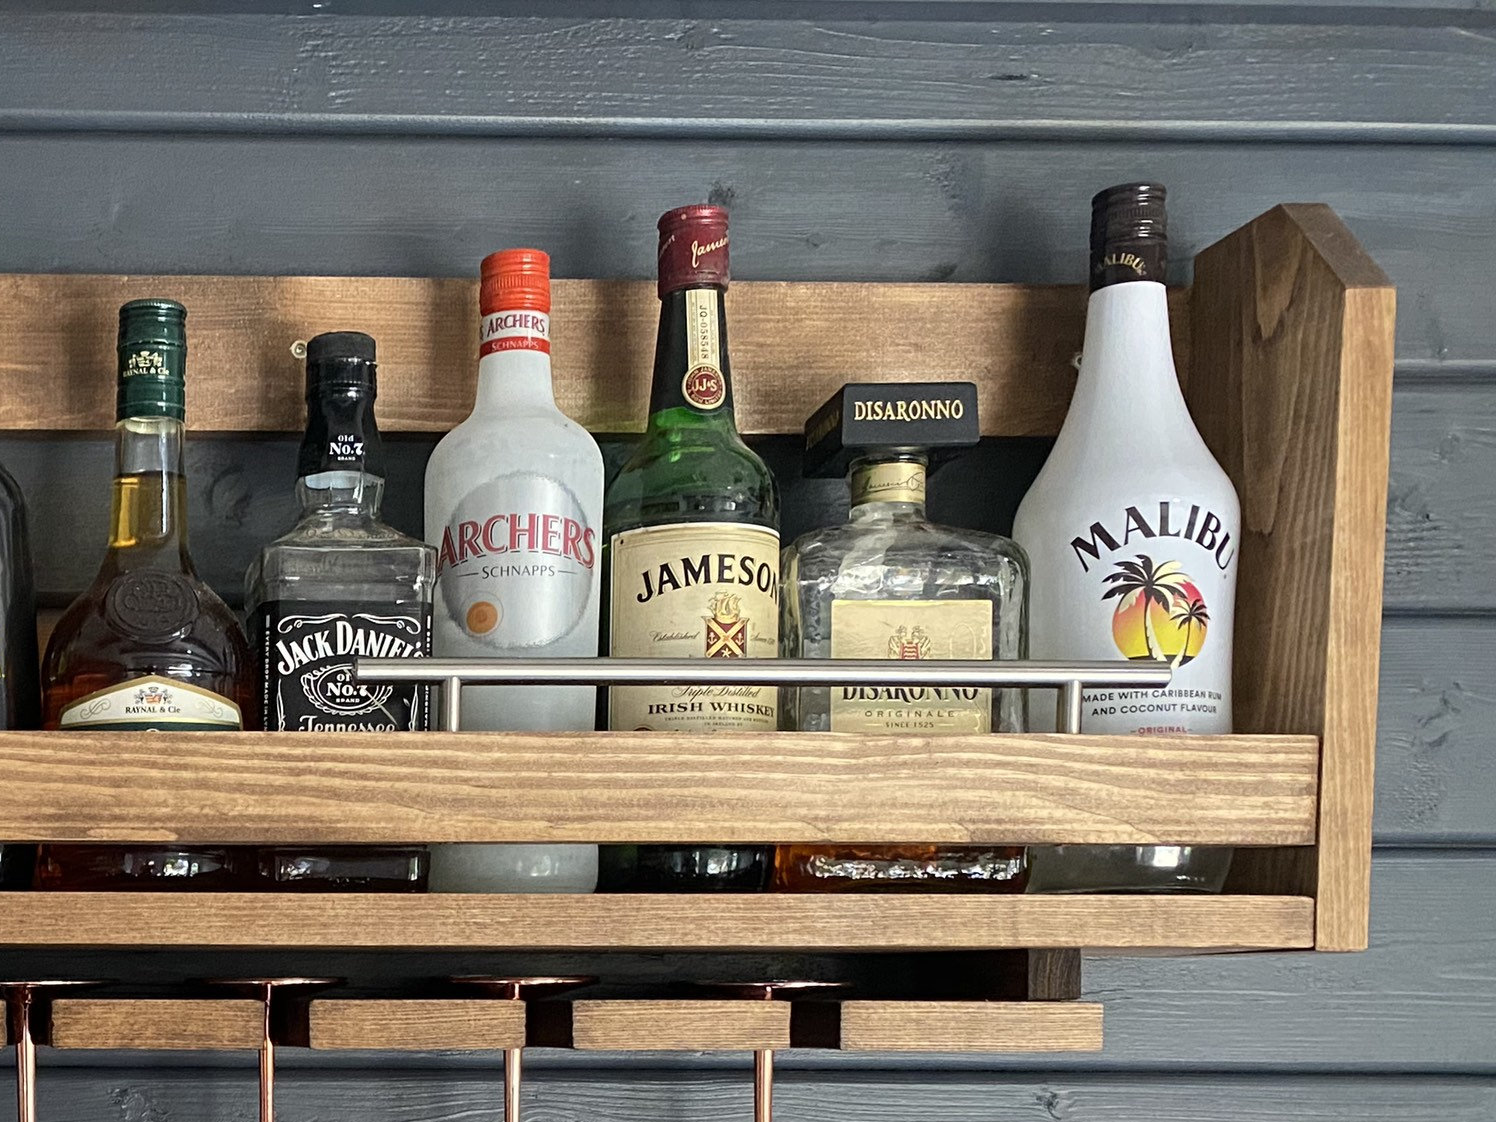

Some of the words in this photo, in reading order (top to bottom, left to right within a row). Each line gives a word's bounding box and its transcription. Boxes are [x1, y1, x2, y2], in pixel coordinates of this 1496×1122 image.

[487, 314, 545, 337] ARCHERS
[492, 341, 539, 352] SCHNAPPS
[854, 399, 964, 421] DISARONNO
[337, 434, 354, 442] Old
[1071, 501, 1235, 573] MALIBU
[437, 513, 596, 577] ARCHERS
[481, 565, 555, 579] SCHNAPPS
[276, 630, 333, 675] JACK
[1083, 692, 1114, 702] MADE
[1118, 691, 1148, 700] WITH
[1152, 690, 1205, 698] CARIBBEAN
[1208, 691, 1222, 701] RUM
[125, 706, 157, 714] RAYNAL
[648, 702, 703, 714] IRISH
[710, 702, 775, 717] WHISKEY
[865, 710, 955, 718] ORIGINALE
[1092, 706, 1116, 716] AND
[1120, 704, 1177, 714] COCONUT
[1181, 704, 1217, 713] FLAVOUR
[1138, 726, 1188, 735] ORIGINAL
